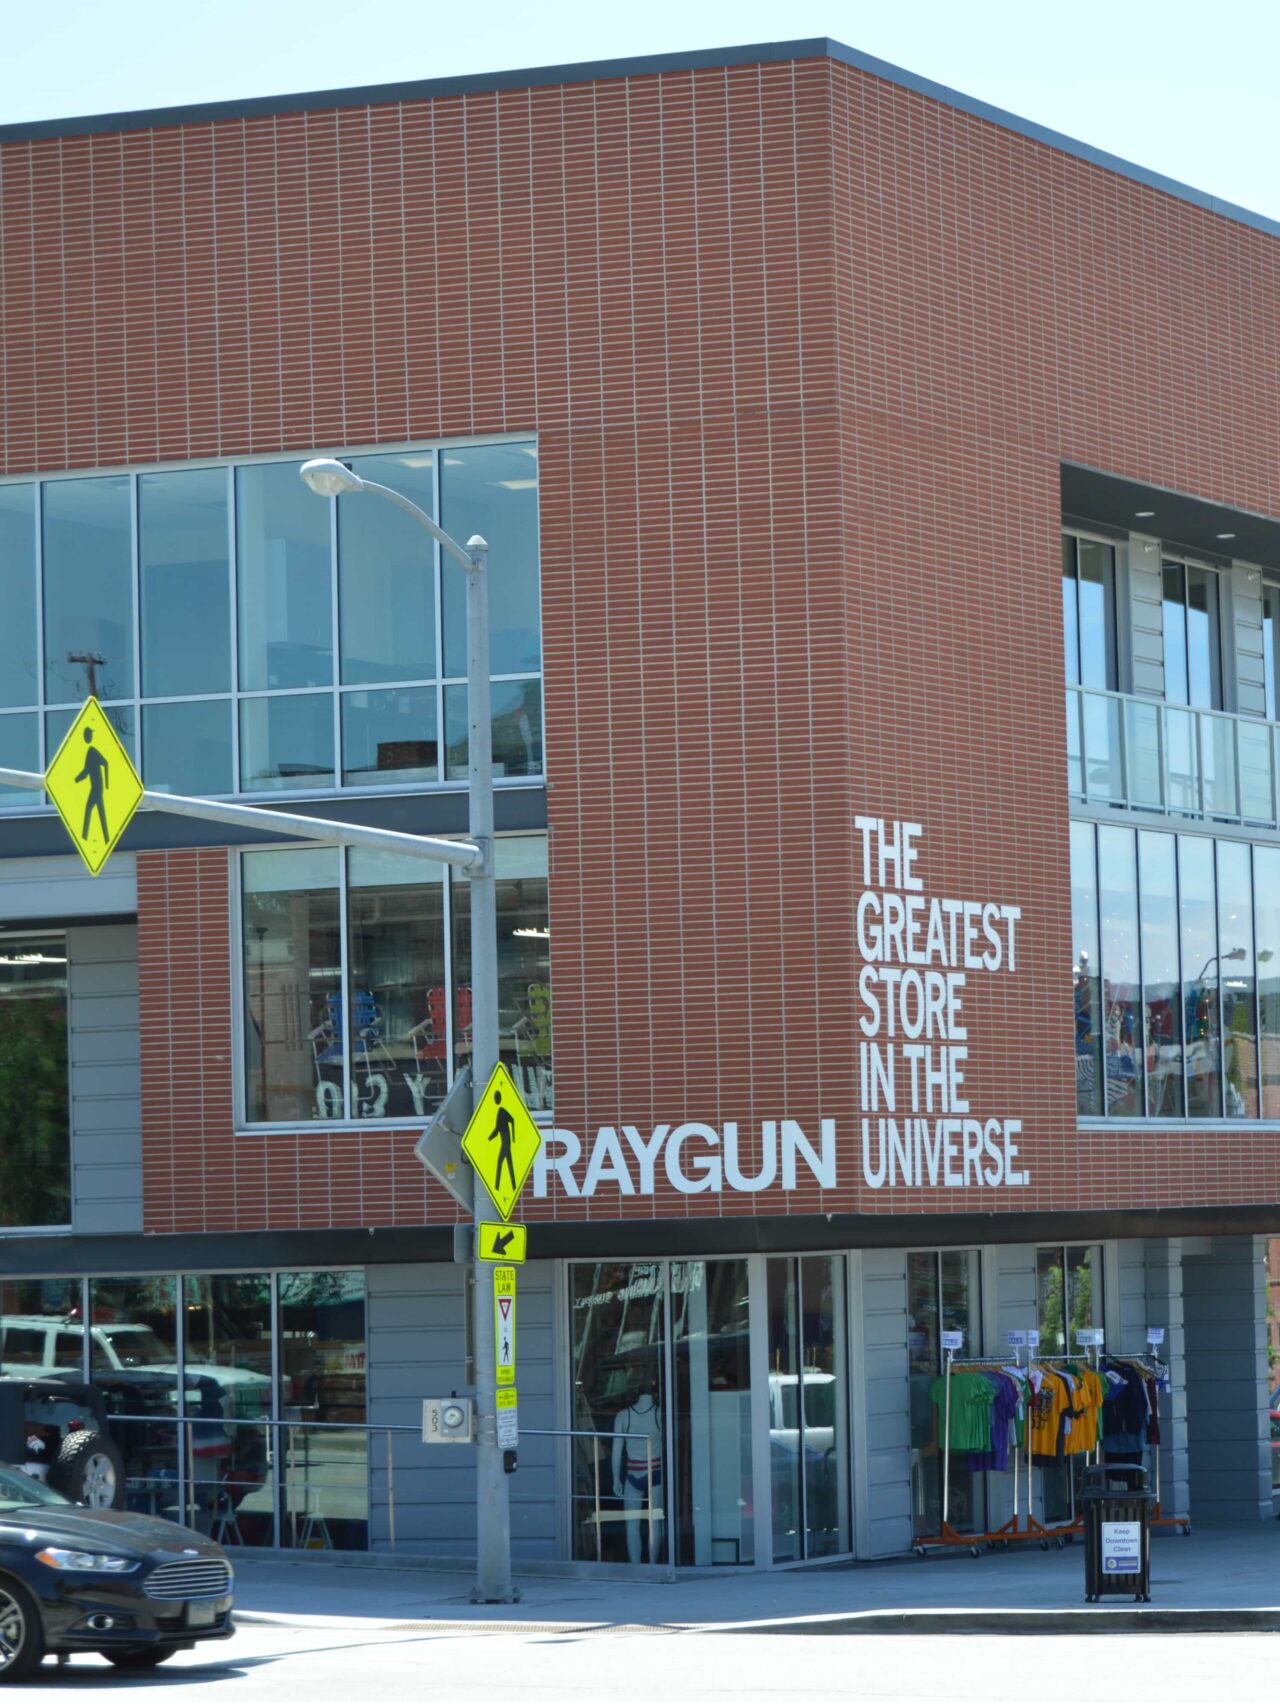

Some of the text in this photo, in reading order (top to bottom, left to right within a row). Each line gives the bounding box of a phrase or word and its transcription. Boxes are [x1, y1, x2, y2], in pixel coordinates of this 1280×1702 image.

[855, 816, 923, 891] THE
[857, 891, 1021, 971] GREATEST
[859, 966, 967, 1040] STORE
[860, 1041, 969, 1113] IN THE
[533, 1119, 837, 1198] RAYGUN
[862, 1118, 1030, 1188] UNIVERSE.
[495, 1270, 514, 1281] STATE
[497, 1282, 511, 1293] LAW
[431, 1408, 439, 1432] 503
